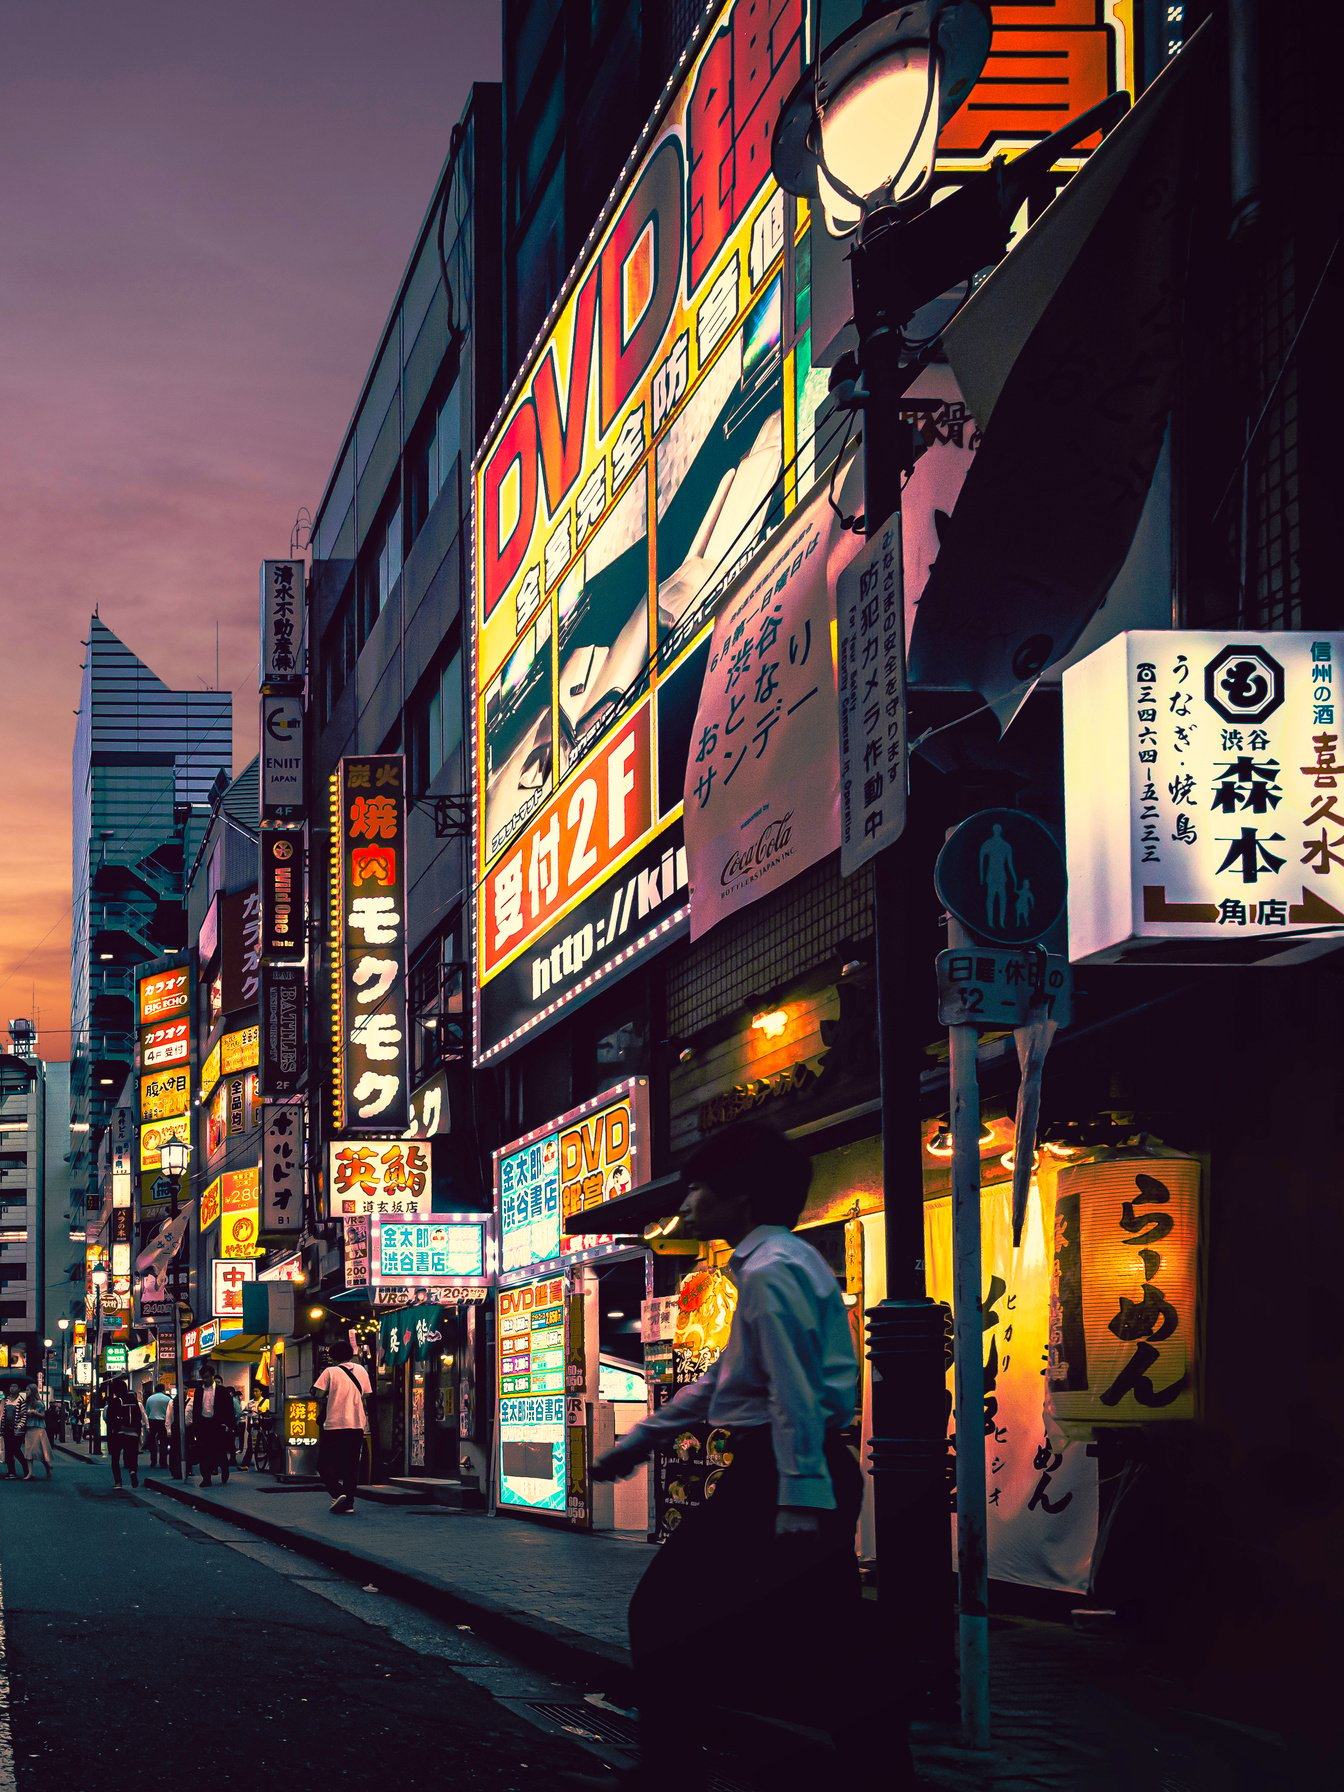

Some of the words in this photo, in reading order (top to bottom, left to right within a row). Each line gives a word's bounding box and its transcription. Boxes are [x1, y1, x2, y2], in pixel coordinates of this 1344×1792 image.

[725, 604, 784, 695] 渋谷
[882, 529, 903, 785] みなさまの安全を守ります
[694, 617, 812, 766] おとなり
[858, 560, 885, 840] 防犯カメラ作動中
[1309, 639, 1336, 726] 信州の酒
[692, 686, 819, 809] サンデー
[1167, 653, 1199, 847] うなぎ・焼鳥
[1219, 727, 1273, 752] 渋谷
[266, 757, 301, 770] ENIIT
[271, 774, 298, 784] JAPAN
[347, 764, 400, 788] 炭火
[275, 806, 293, 816] 4F
[843, 781, 852, 843] Operation
[1208, 754, 1289, 885] 森本
[349, 795, 398, 887] 焼肉
[494, 730, 637, 953] 受付2F
[274, 867, 292, 903] Wild
[720, 874, 759, 899] BOTTLERS
[760, 859, 781, 876] JAPAN
[274, 904, 292, 934] One
[1217, 897, 1288, 927] 角店
[144, 975, 187, 997] カラオケ
[144, 1002, 162, 1016] BIG
[162, 994, 188, 1010] ECHO
[347, 896, 403, 1119] モクモク
[144, 1025, 187, 1045] カラオケ
[145, 1075, 187, 1098] 腹八分目
[276, 1081, 290, 1090] 2F
[231, 1080, 243, 1133] 全品均一
[560, 1106, 632, 1185] DVD
[334, 1144, 429, 1198] 英鮨
[502, 1144, 542, 1195] 金太郎
[278, 1216, 290, 1225] B1
[362, 1200, 419, 1214] 道玄坂店
[503, 1179, 558, 1229] 渋谷書店
[383, 1227, 429, 1248] 金太郎
[346, 1266, 367, 1277] 200
[383, 1251, 445, 1272] 渋谷書店
[222, 1266, 245, 1311] 中華
[443, 1288, 469, 1299] 200
[1098, 1172, 1189, 1410] らーめん
[1002, 1293, 1017, 1374] ヒカリ
[289, 1402, 306, 1436] 焼肉
[500, 1397, 564, 1423] 金太郎渋谷書店
[288, 1437, 318, 1446] モクモク
